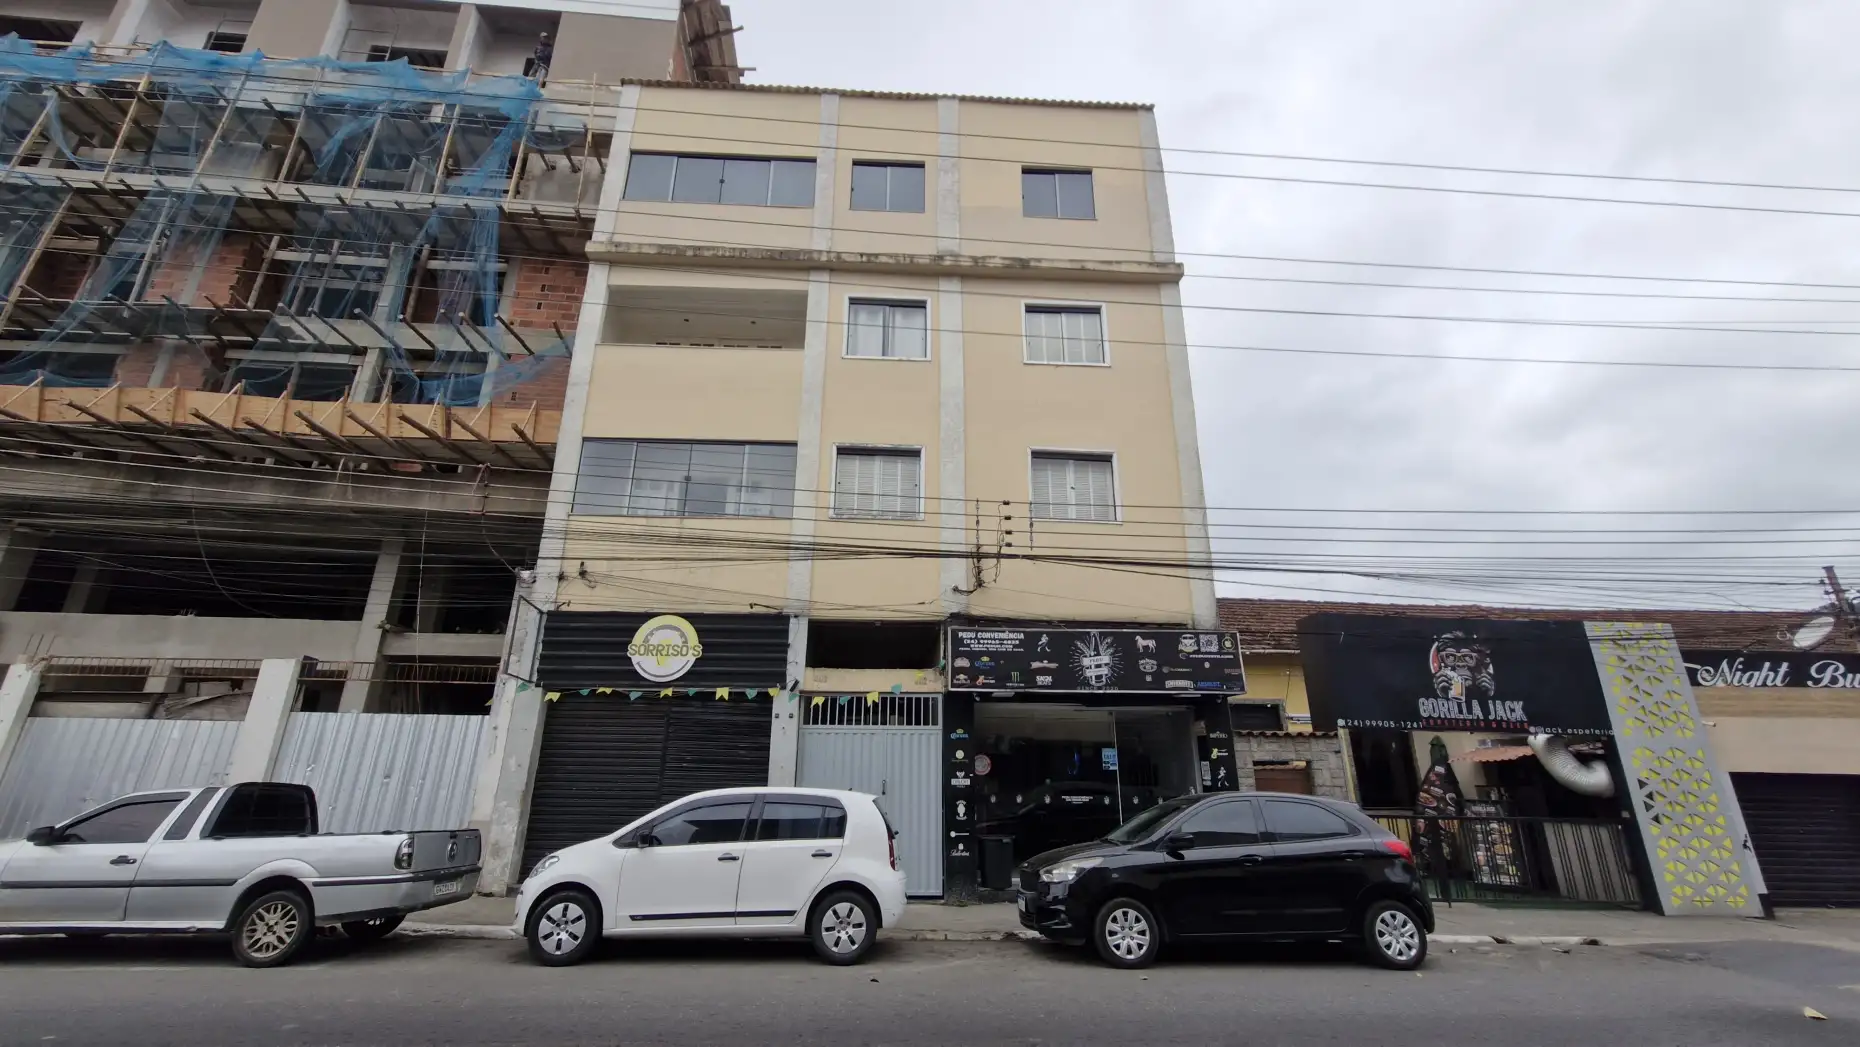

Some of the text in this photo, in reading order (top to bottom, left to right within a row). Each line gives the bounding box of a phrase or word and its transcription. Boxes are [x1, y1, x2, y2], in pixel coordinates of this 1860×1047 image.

[958, 630, 1025, 640] PEDU CONVENIÊNCIA
[628, 643, 702, 657] SORRISO'S
[1697, 657, 1790, 688] Night
[1418, 697, 1529, 721] GORILLA JACK
